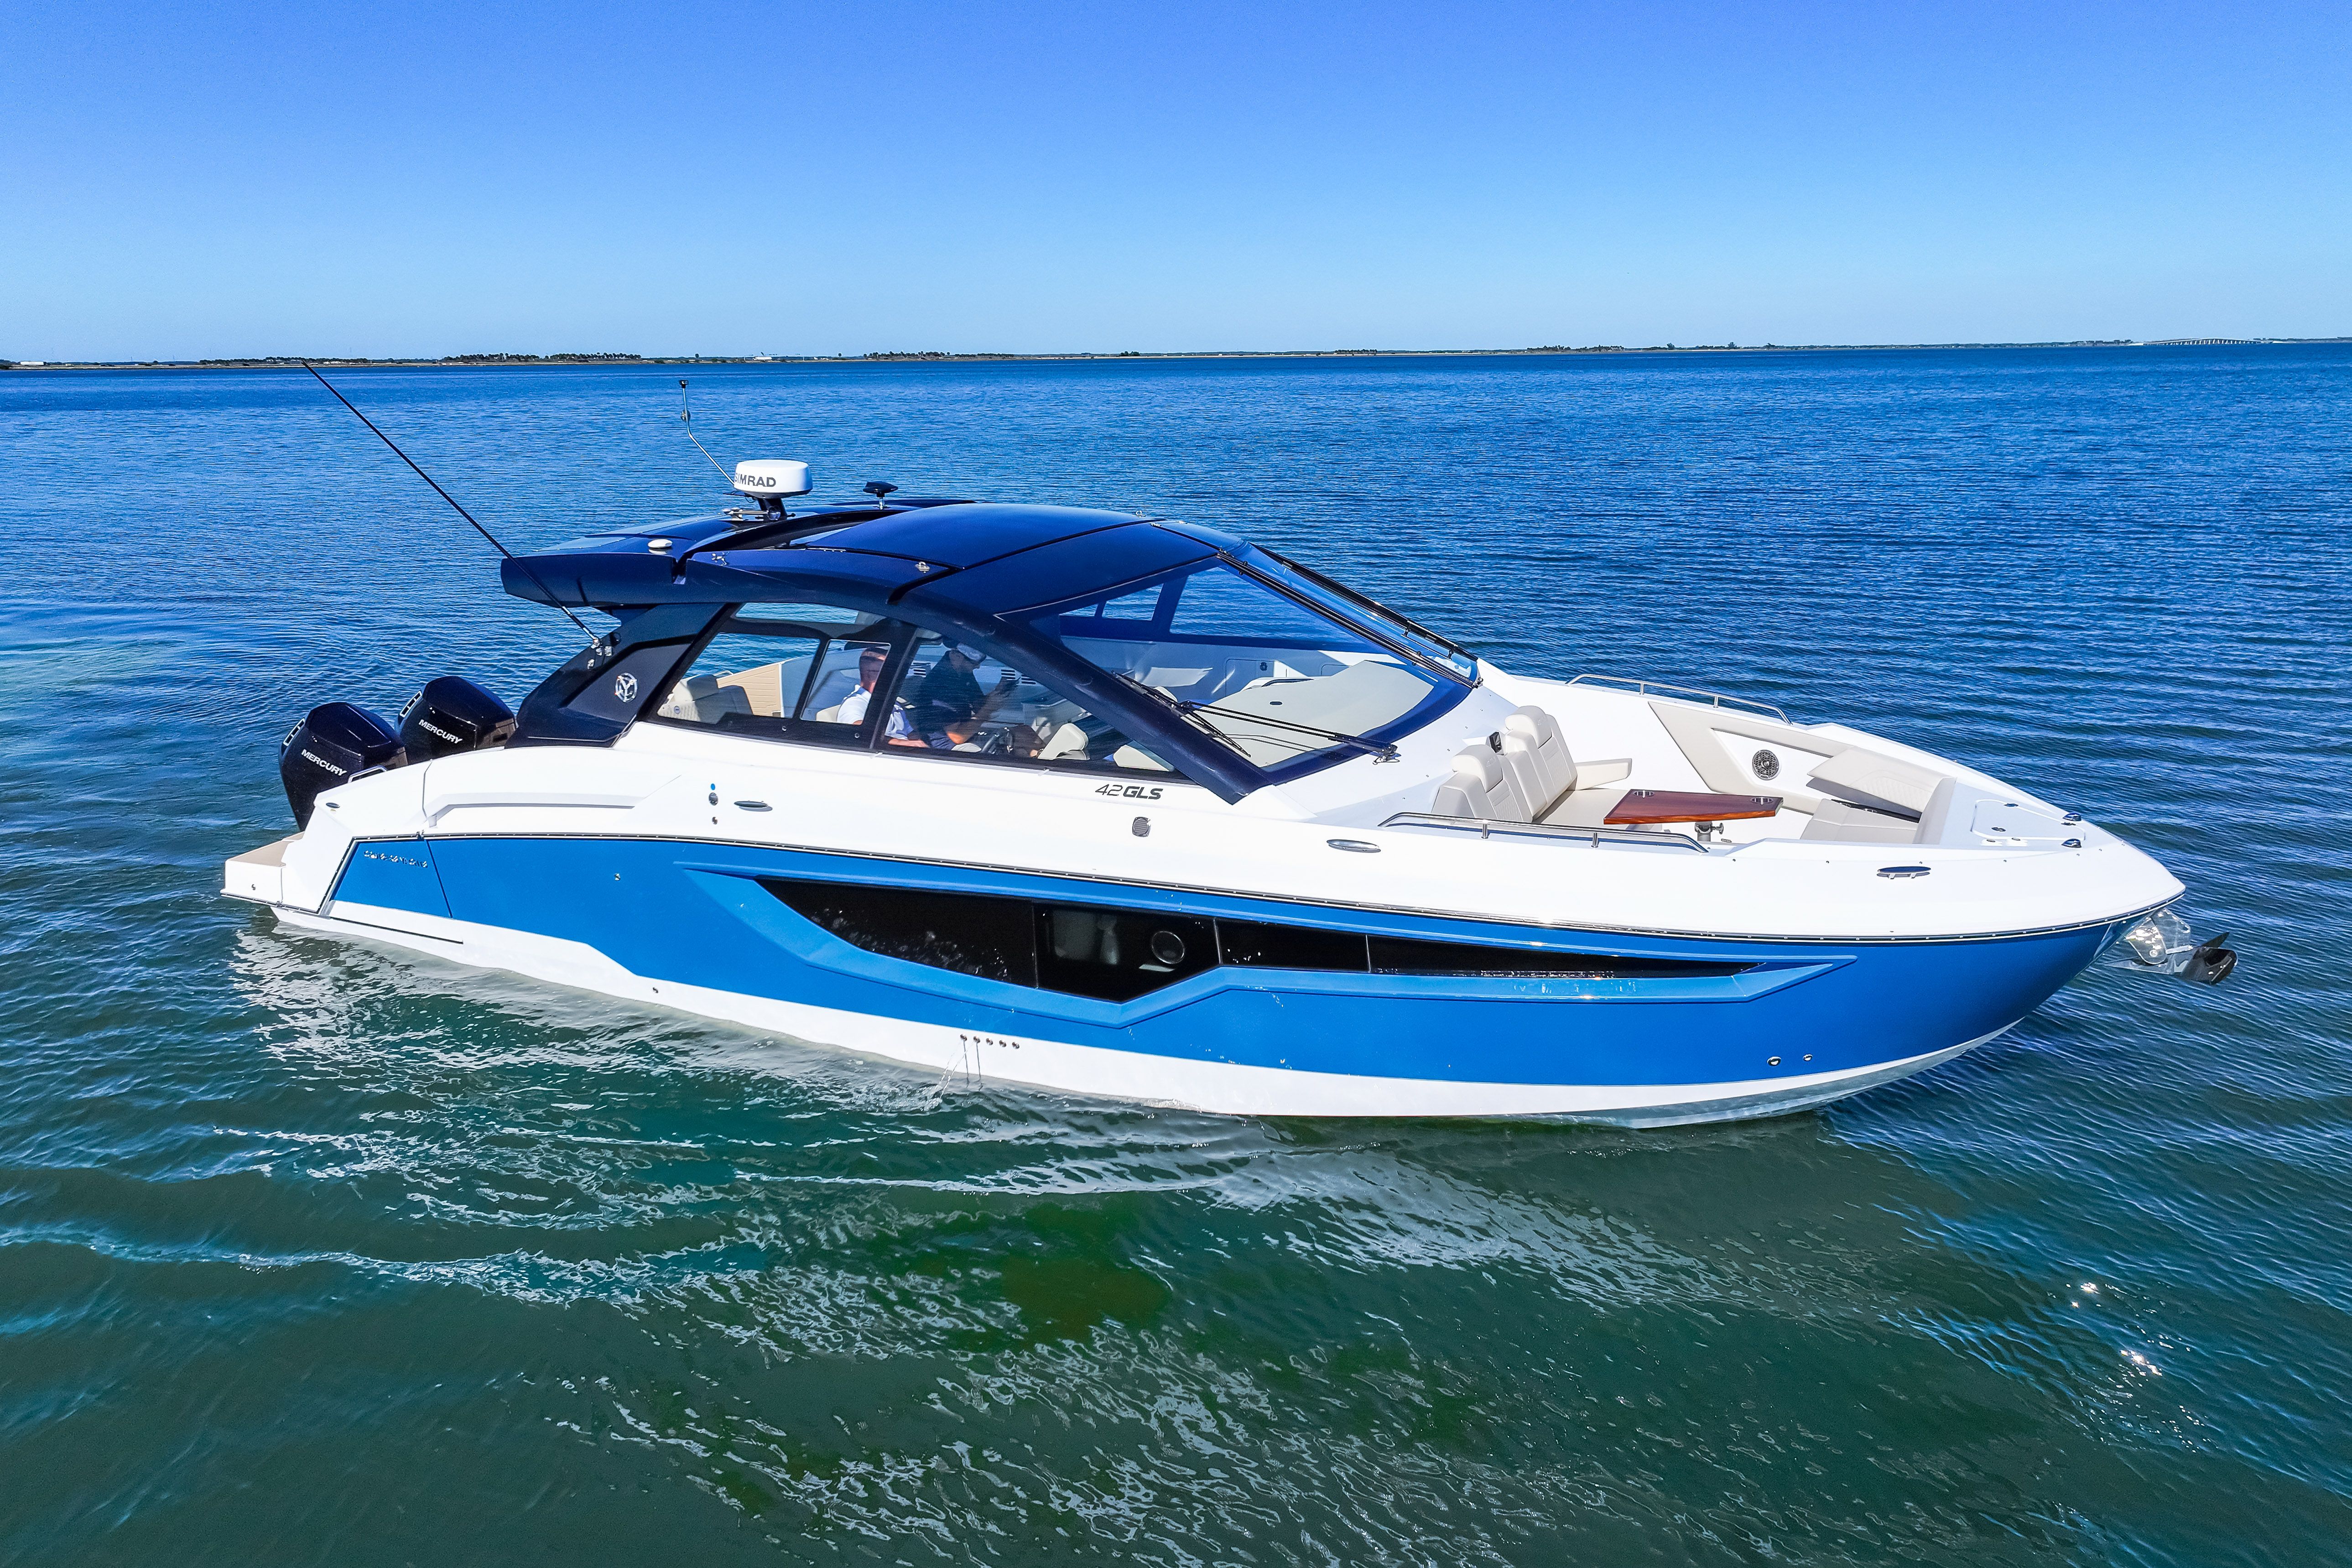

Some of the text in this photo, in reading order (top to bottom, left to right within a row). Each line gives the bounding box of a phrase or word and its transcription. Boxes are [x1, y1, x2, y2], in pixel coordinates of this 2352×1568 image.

[734, 473, 776, 487] SIMRAD
[419, 719, 463, 744] MERCURY
[301, 749, 347, 776] MERCURY
